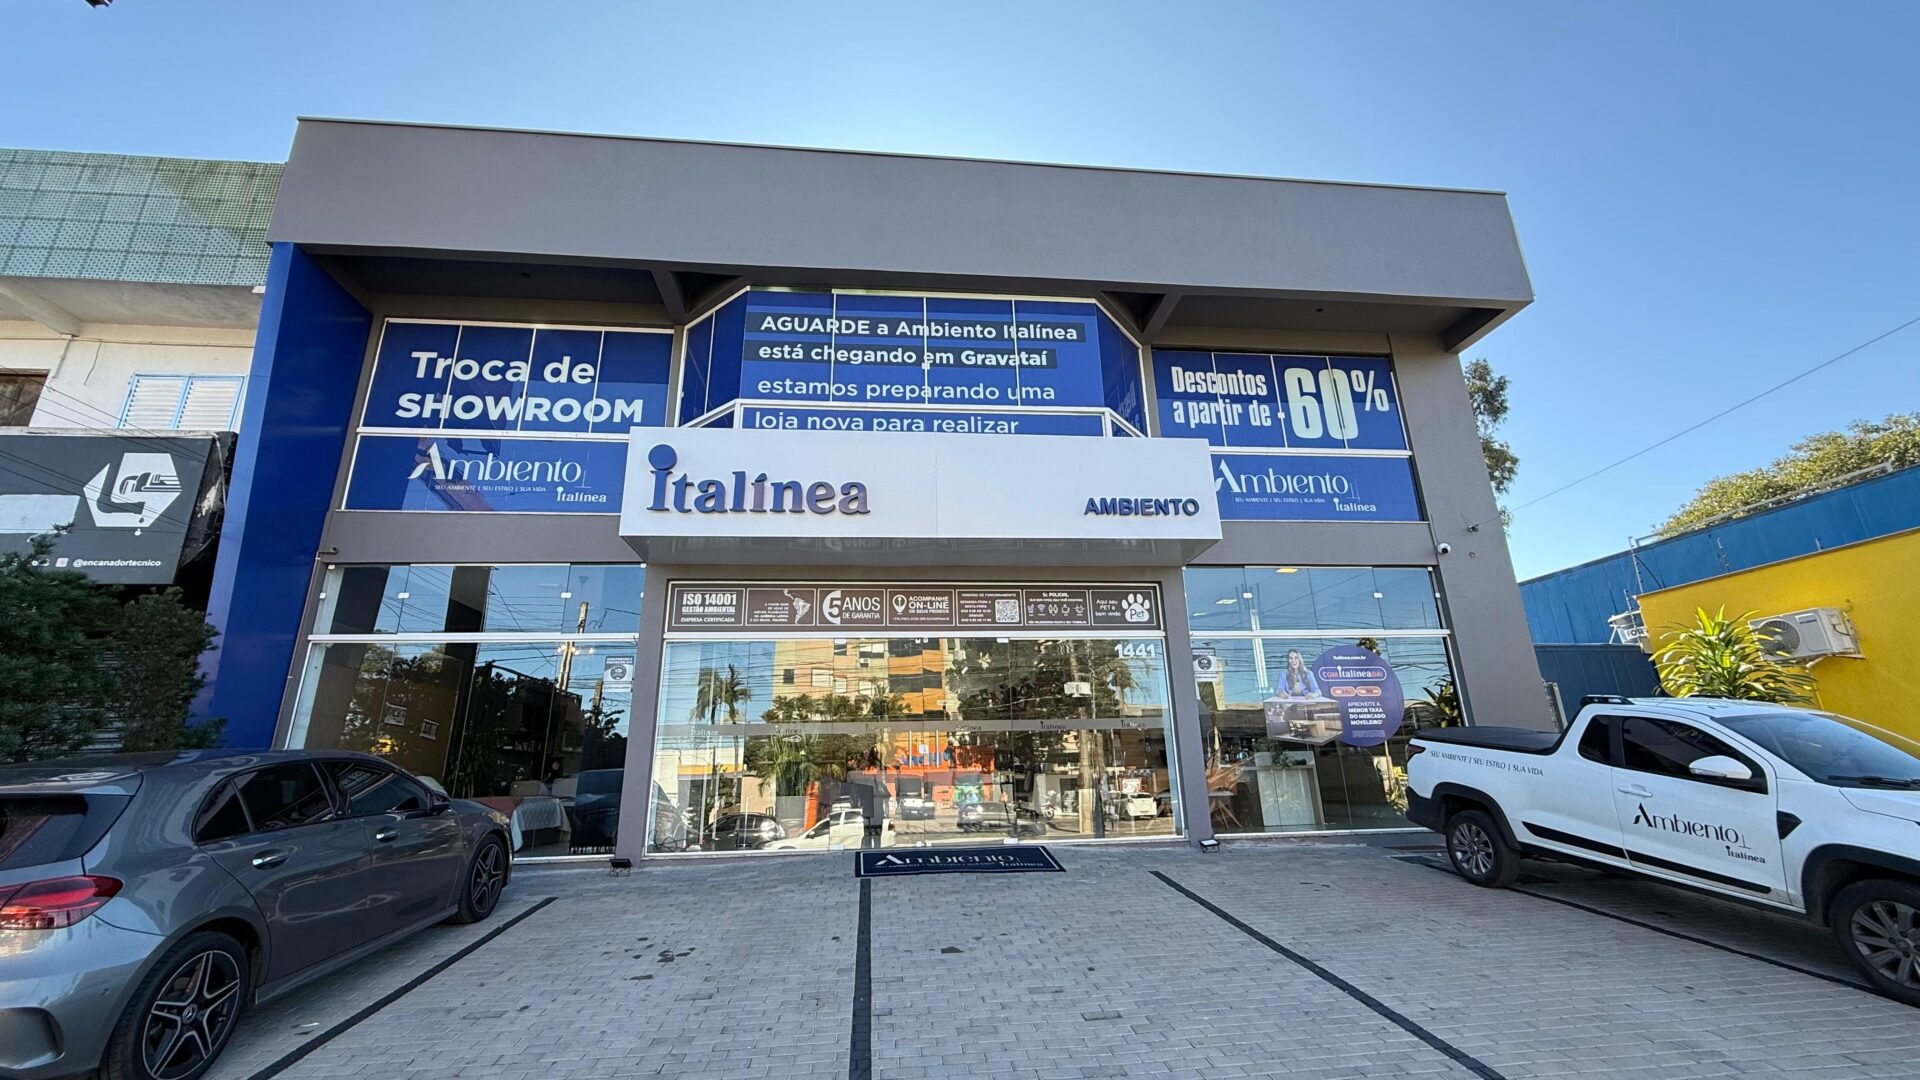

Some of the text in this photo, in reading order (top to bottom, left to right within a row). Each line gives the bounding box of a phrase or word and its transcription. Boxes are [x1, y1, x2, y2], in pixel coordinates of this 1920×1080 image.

[760, 316, 1078, 340] AGUARDE a Ambiento Italínea
[758, 344, 1047, 366] está chegando em Gravataí
[411, 351, 595, 384] Troca de
[757, 378, 1055, 401] estamos preparando uma
[1171, 366, 1267, 396] Descontos
[395, 393, 643, 423] SHOWROOM
[1173, 400, 1272, 428] a partir de
[1284, 367, 1390, 440] 60%
[755, 411, 1019, 433] loja nova para realizar
[407, 441, 582, 482] Ambiento
[1216, 459, 1349, 494] Ambiento
[1084, 497, 1200, 517] AMBIENTO
[73, 559, 161, 567] @encanadortecnico
[683, 593, 736, 605] ISO 14001
[843, 597, 880, 611] ANOS
[1130, 609, 1144, 620] Pet
[1115, 643, 1155, 658] 1441
[1442, 752, 1467, 762] AMBIENTE
[1486, 759, 1506, 769] ESTILO
[1513, 764, 1526, 773] SUA
[1527, 766, 1544, 776] VIDA
[1633, 802, 1739, 844] Ambiento
